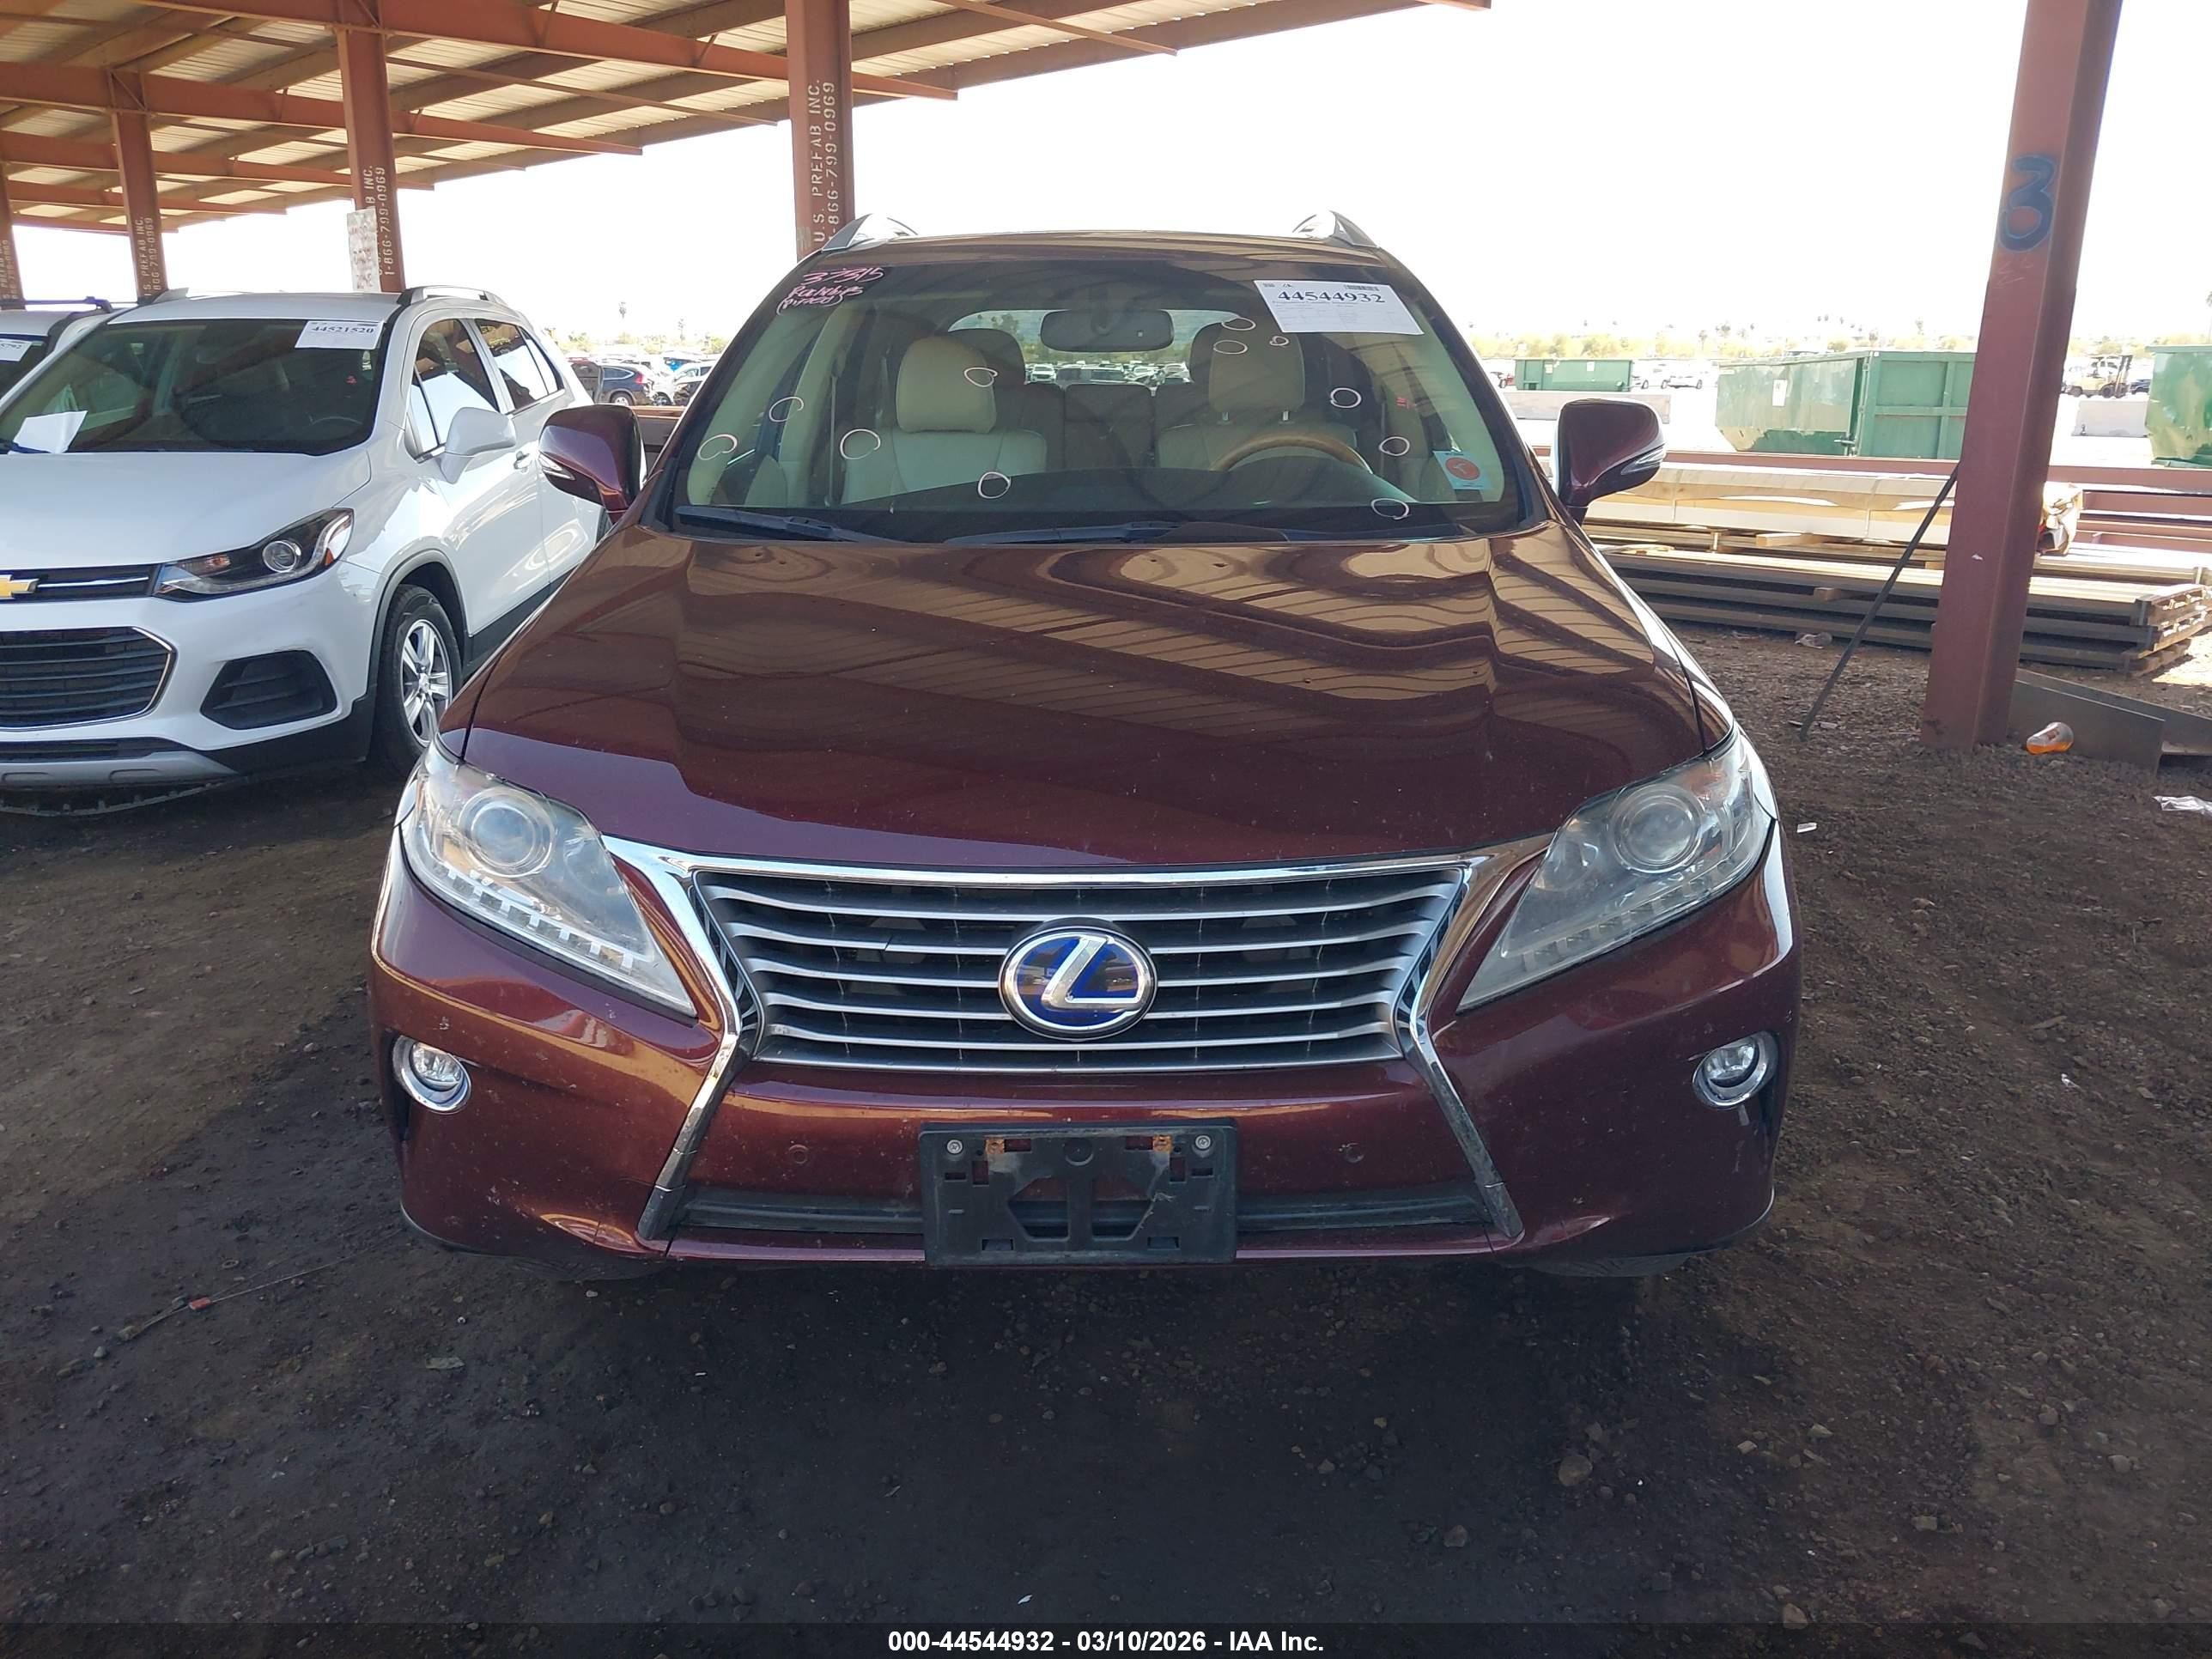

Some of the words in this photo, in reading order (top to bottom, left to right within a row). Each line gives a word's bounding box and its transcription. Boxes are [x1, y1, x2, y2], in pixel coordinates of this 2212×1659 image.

[808, 79, 821, 114] INC.
[363, 166, 374, 190] INC.
[810, 125, 823, 197] PREFAB
[1997, 155, 2056, 252] 3
[375, 167, 395, 276] 1-866-799-0969
[812, 208, 826, 242] U.S.
[1278, 290, 1385, 303] 44544932
